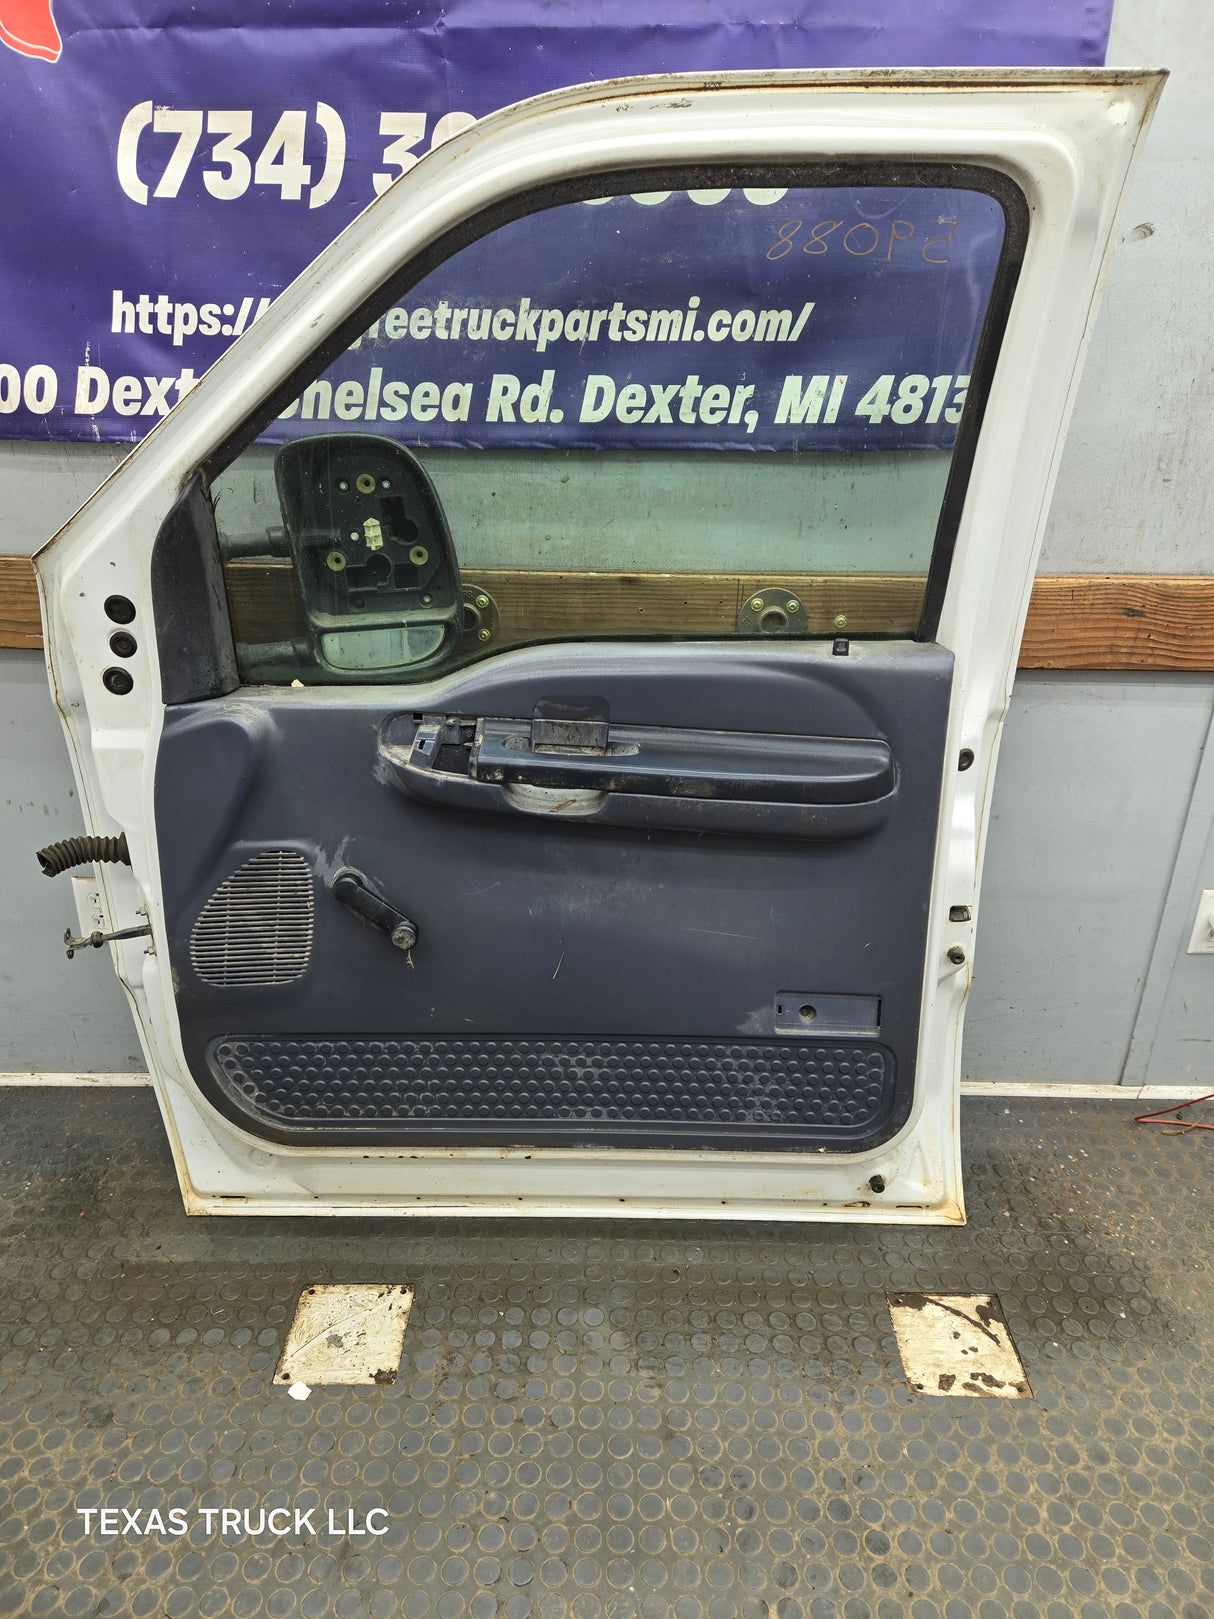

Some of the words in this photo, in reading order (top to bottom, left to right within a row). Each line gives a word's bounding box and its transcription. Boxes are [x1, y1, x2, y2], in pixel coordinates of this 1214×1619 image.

[116, 100, 346, 209] (734)
[74, 366, 201, 416] Dext
[485, 369, 564, 424] Rd.
[578, 374, 759, 434] Dexter,
[774, 375, 848, 424] MI
[854, 374, 972, 424] 4813
